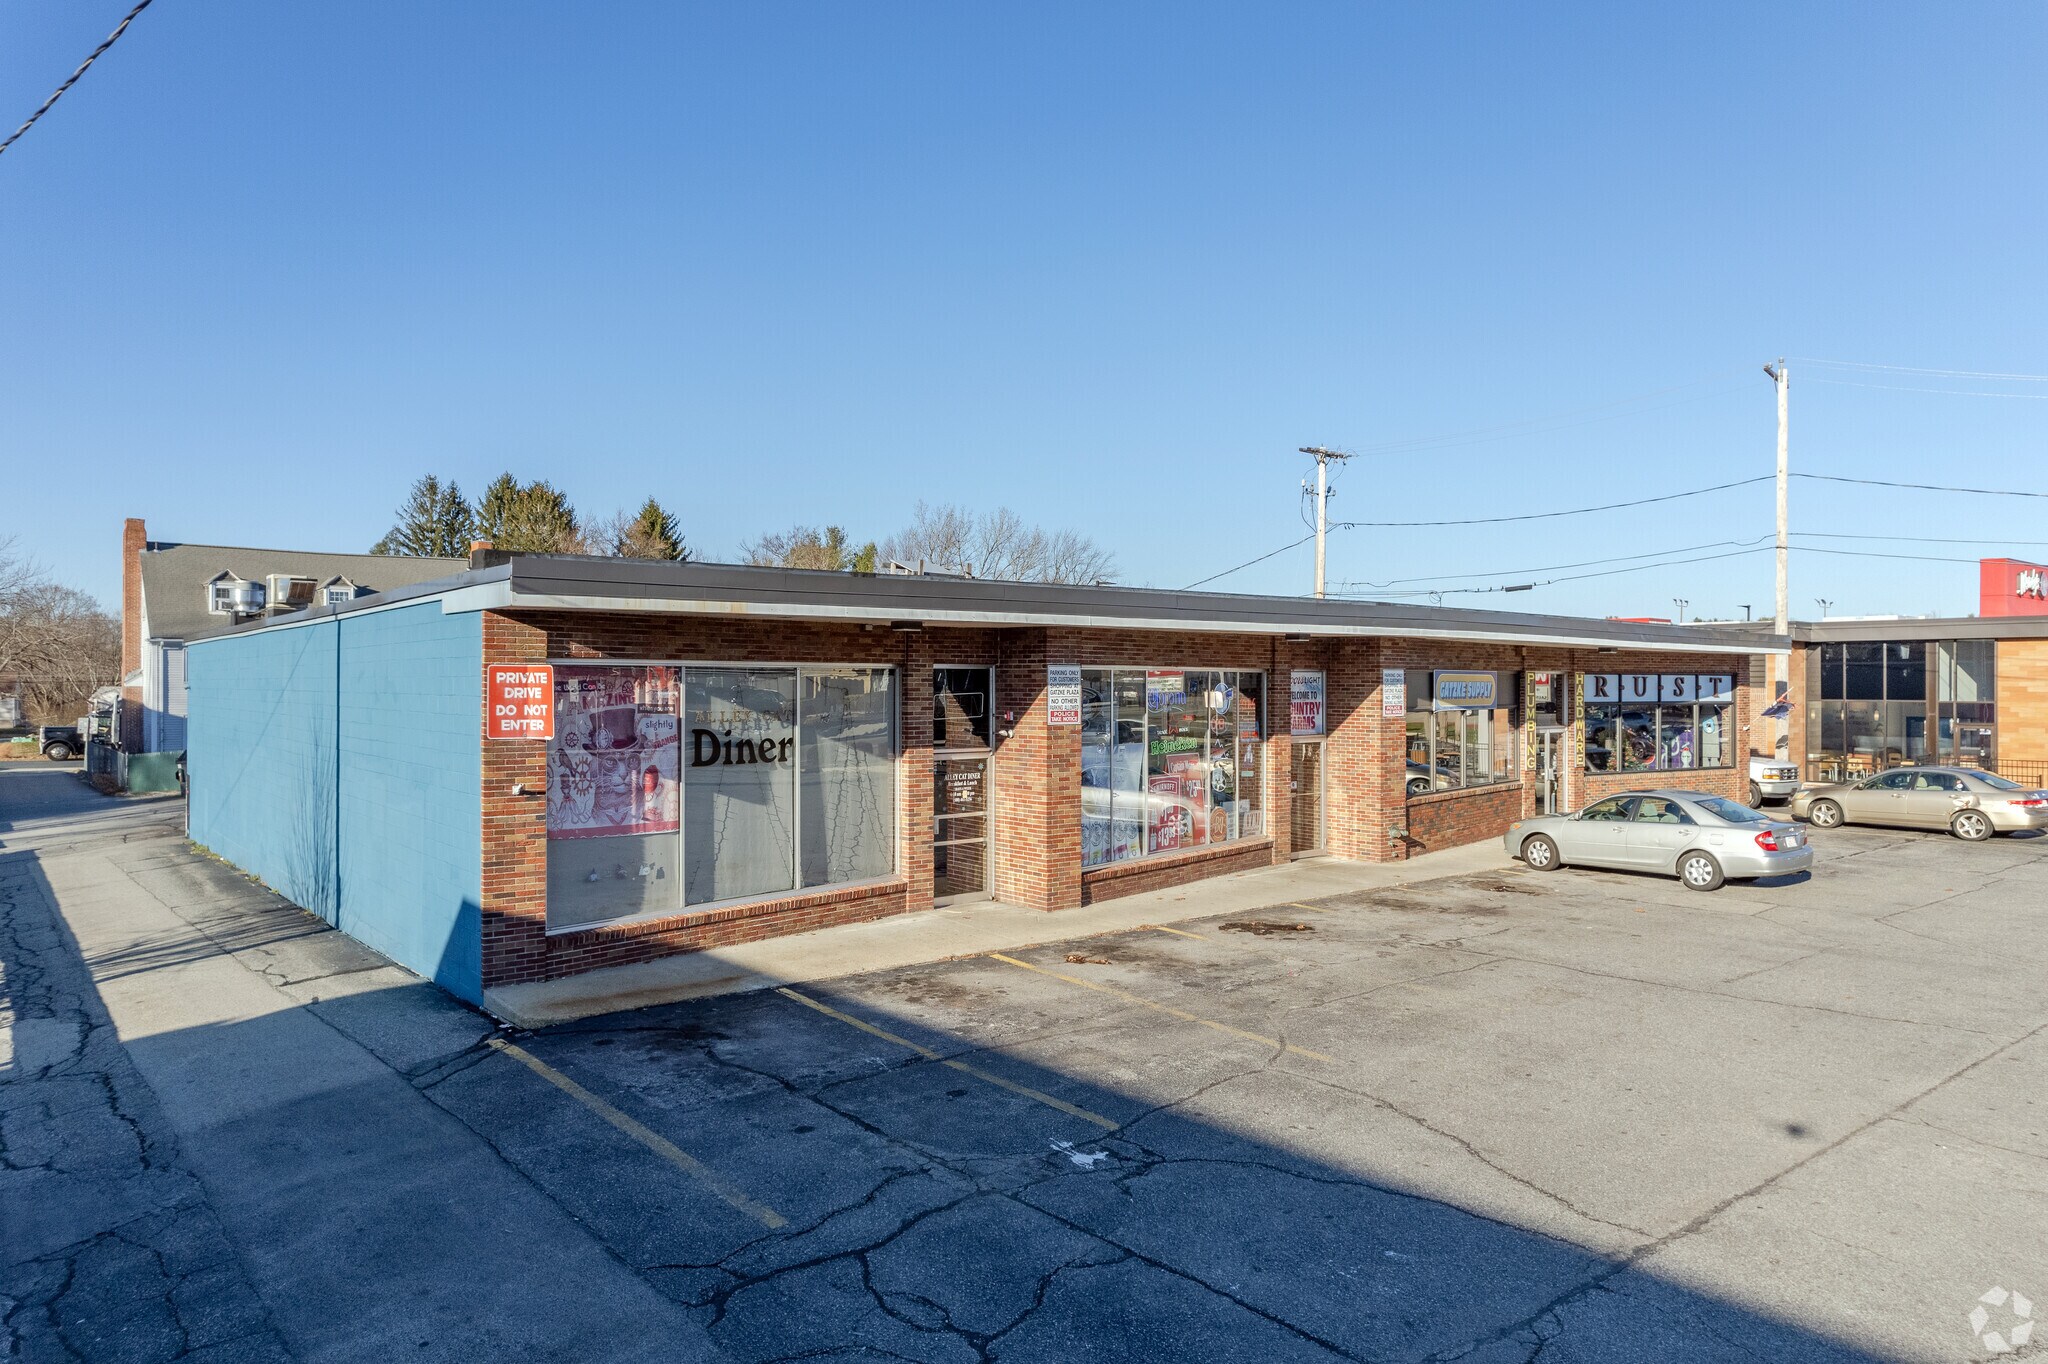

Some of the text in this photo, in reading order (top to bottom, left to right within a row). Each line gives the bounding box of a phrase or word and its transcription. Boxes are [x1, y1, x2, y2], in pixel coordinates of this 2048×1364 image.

[496, 672, 548, 684] PRIVATE
[1304, 676, 1321, 684] LIGHT
[504, 687, 542, 699] DRIVE
[1291, 691, 1318, 700] ELCOME TO
[1440, 681, 1492, 699] GATZKE SUPPLY
[1147, 688, 1187, 710] Corona
[495, 704, 548, 716] DO NOT
[1291, 701, 1321, 715] OUNTRY
[695, 709, 793, 723] ALLEY CAT
[1291, 716, 1316, 730] ARMS
[1526, 672, 1535, 769] PLUMBING
[1575, 673, 1584, 765] HARDWARE
[501, 719, 545, 731] ENTER
[645, 719, 674, 731] slightly
[691, 728, 794, 767] Diner
[1151, 738, 1198, 756] Heineken
